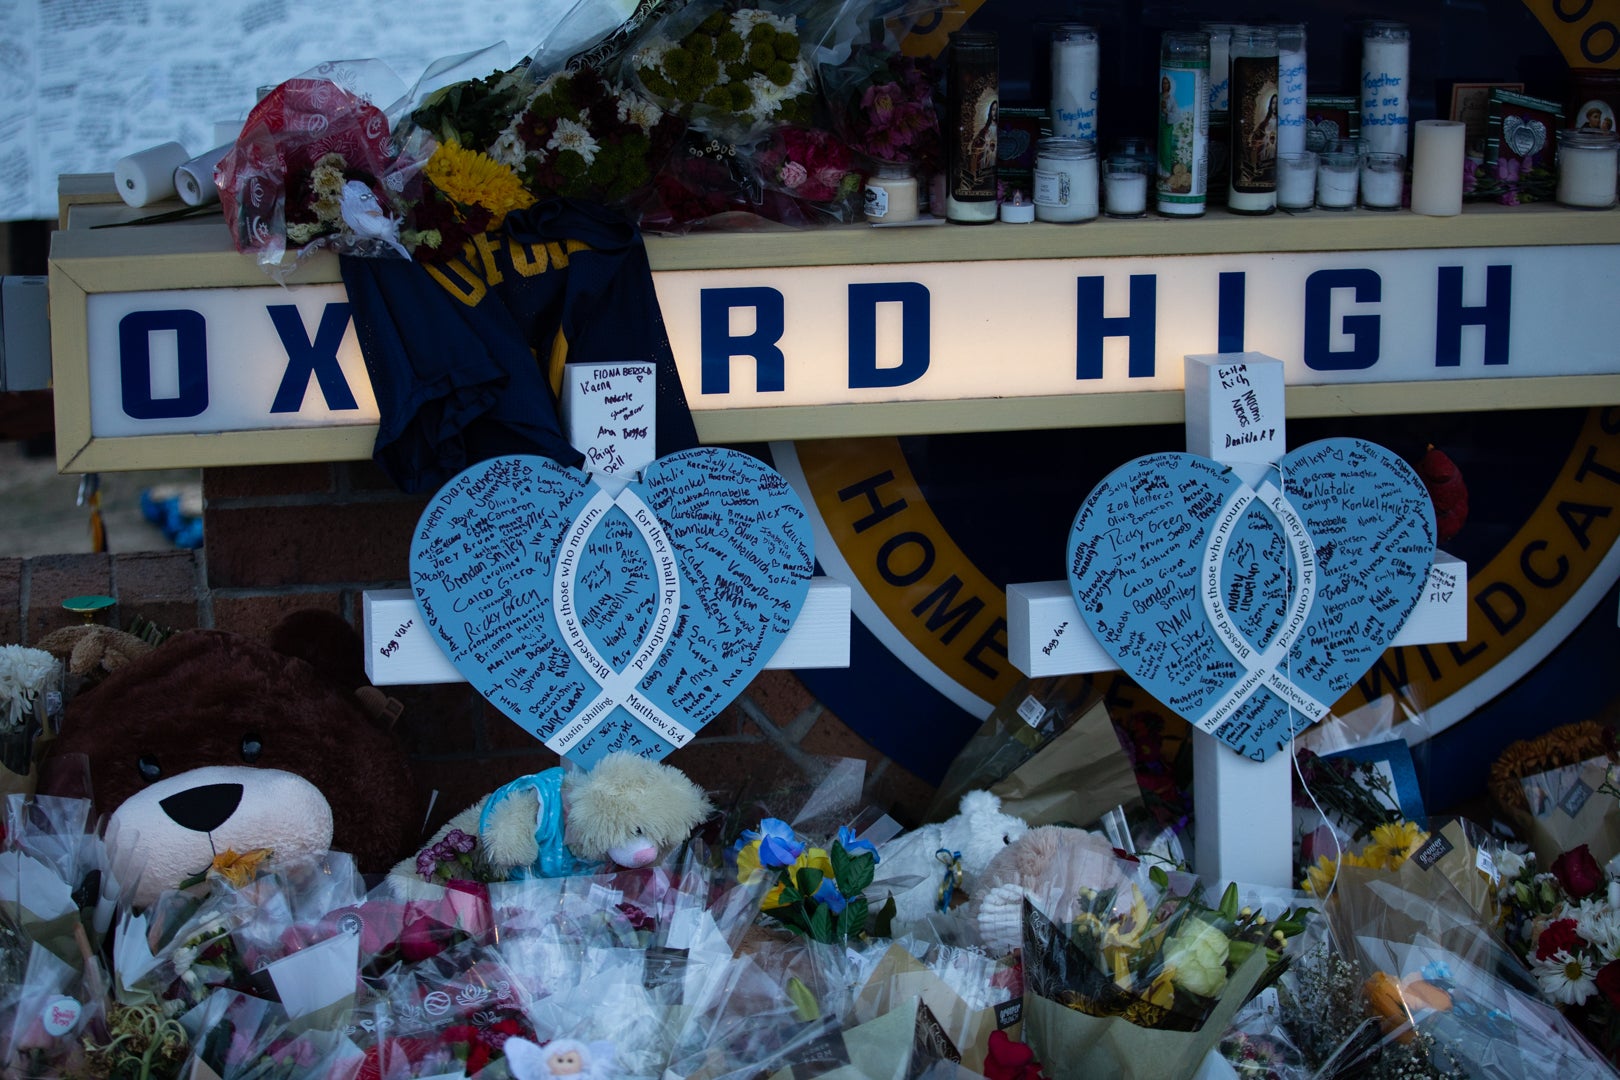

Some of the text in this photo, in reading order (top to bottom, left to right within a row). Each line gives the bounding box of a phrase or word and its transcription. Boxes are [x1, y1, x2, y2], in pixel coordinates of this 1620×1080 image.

[1076, 264, 1513, 381] HIGH
[702, 487, 751, 499] Annabelle
[1313, 480, 1356, 498] Natalie
[1341, 496, 1380, 512] Konkel
[487, 502, 535, 522] Cameron
[1298, 539, 1314, 568] shall
[560, 507, 610, 681] Blessed are those who mourn,
[631, 509, 677, 671] for they shall be comforted.
[1208, 495, 1251, 661] Blessed are those who mourn,
[1302, 570, 1313, 585] be
[1155, 602, 1193, 639] RYAN
[1203, 698, 1237, 731] Madisyn
[1233, 668, 1267, 701] Baldwin
[1304, 702, 1322, 718] 5:4
[557, 697, 614, 748] Justin Shilling
[625, 693, 685, 744] Matthew 5:4
